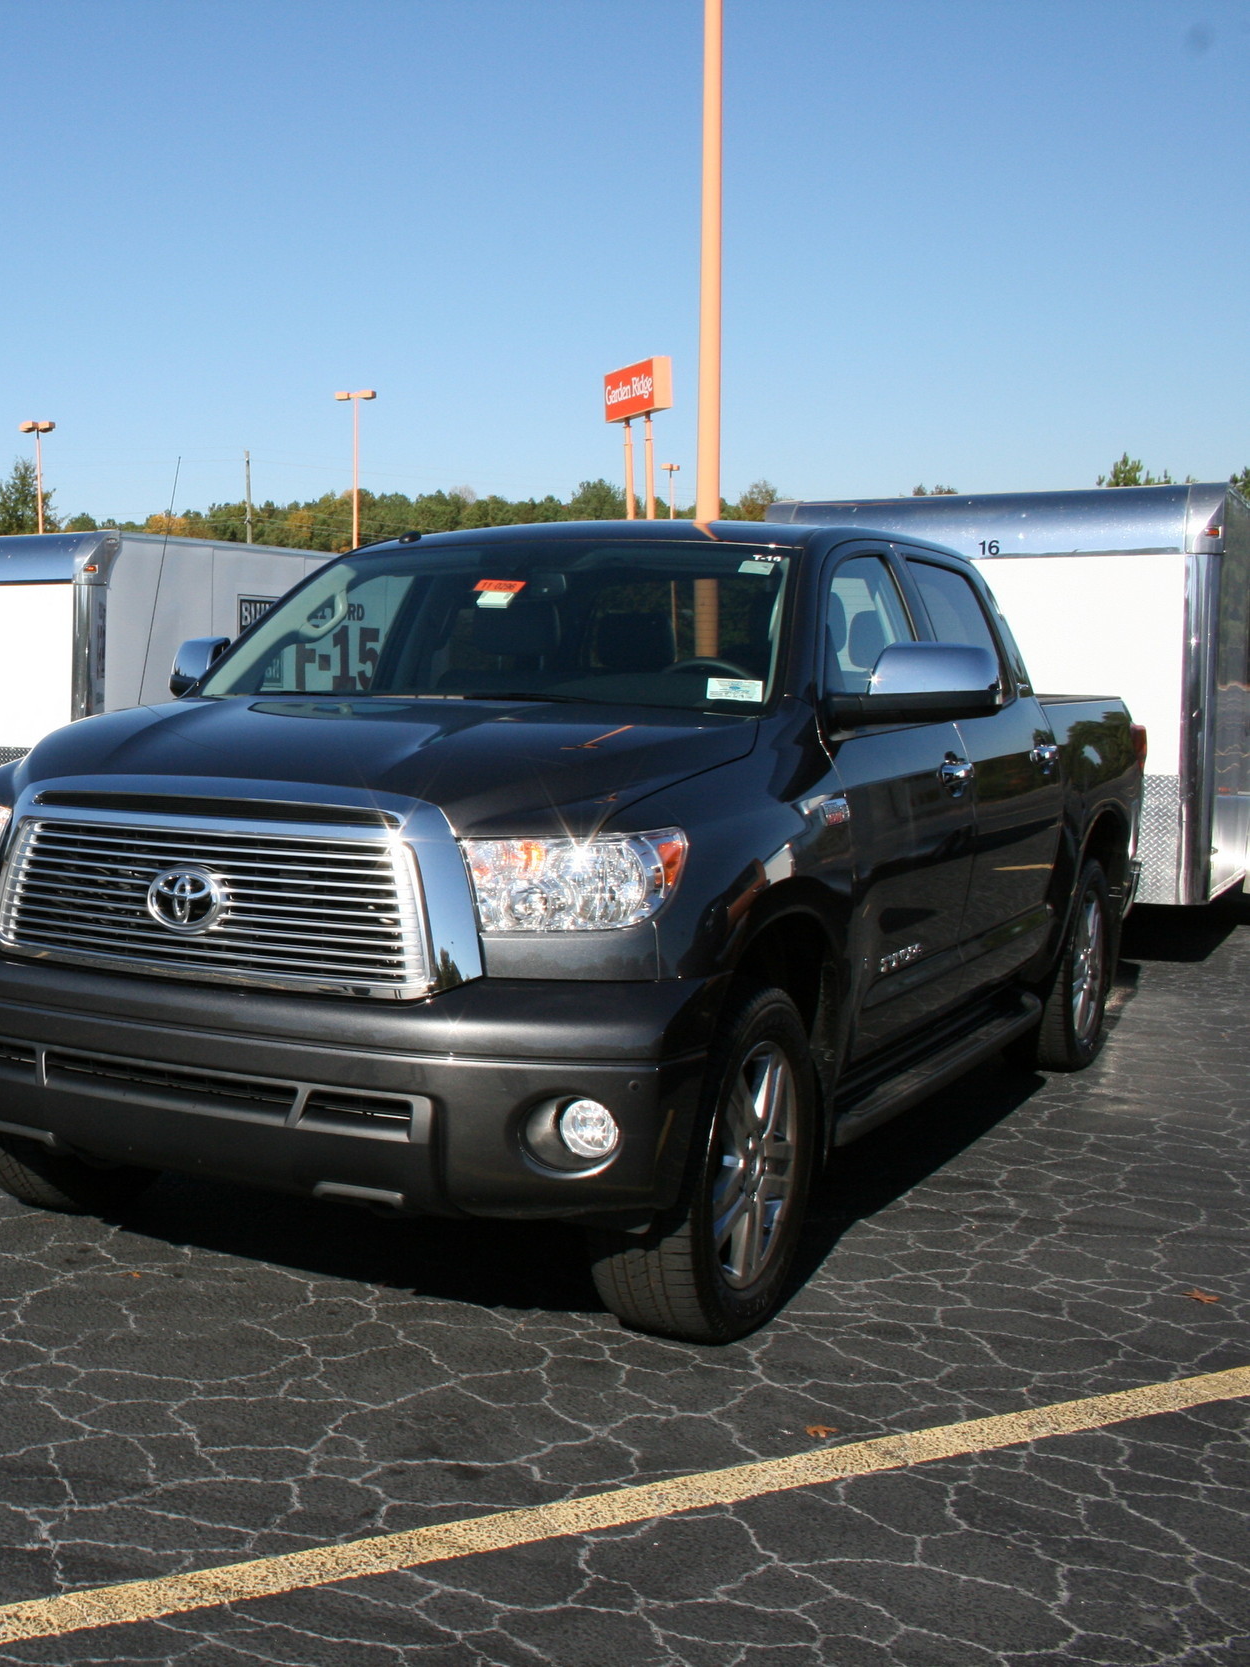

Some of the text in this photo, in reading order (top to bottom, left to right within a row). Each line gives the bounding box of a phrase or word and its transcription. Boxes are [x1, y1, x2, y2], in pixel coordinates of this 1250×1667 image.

[605, 374, 653, 405] Garden Ridge
[978, 539, 1000, 556] 16
